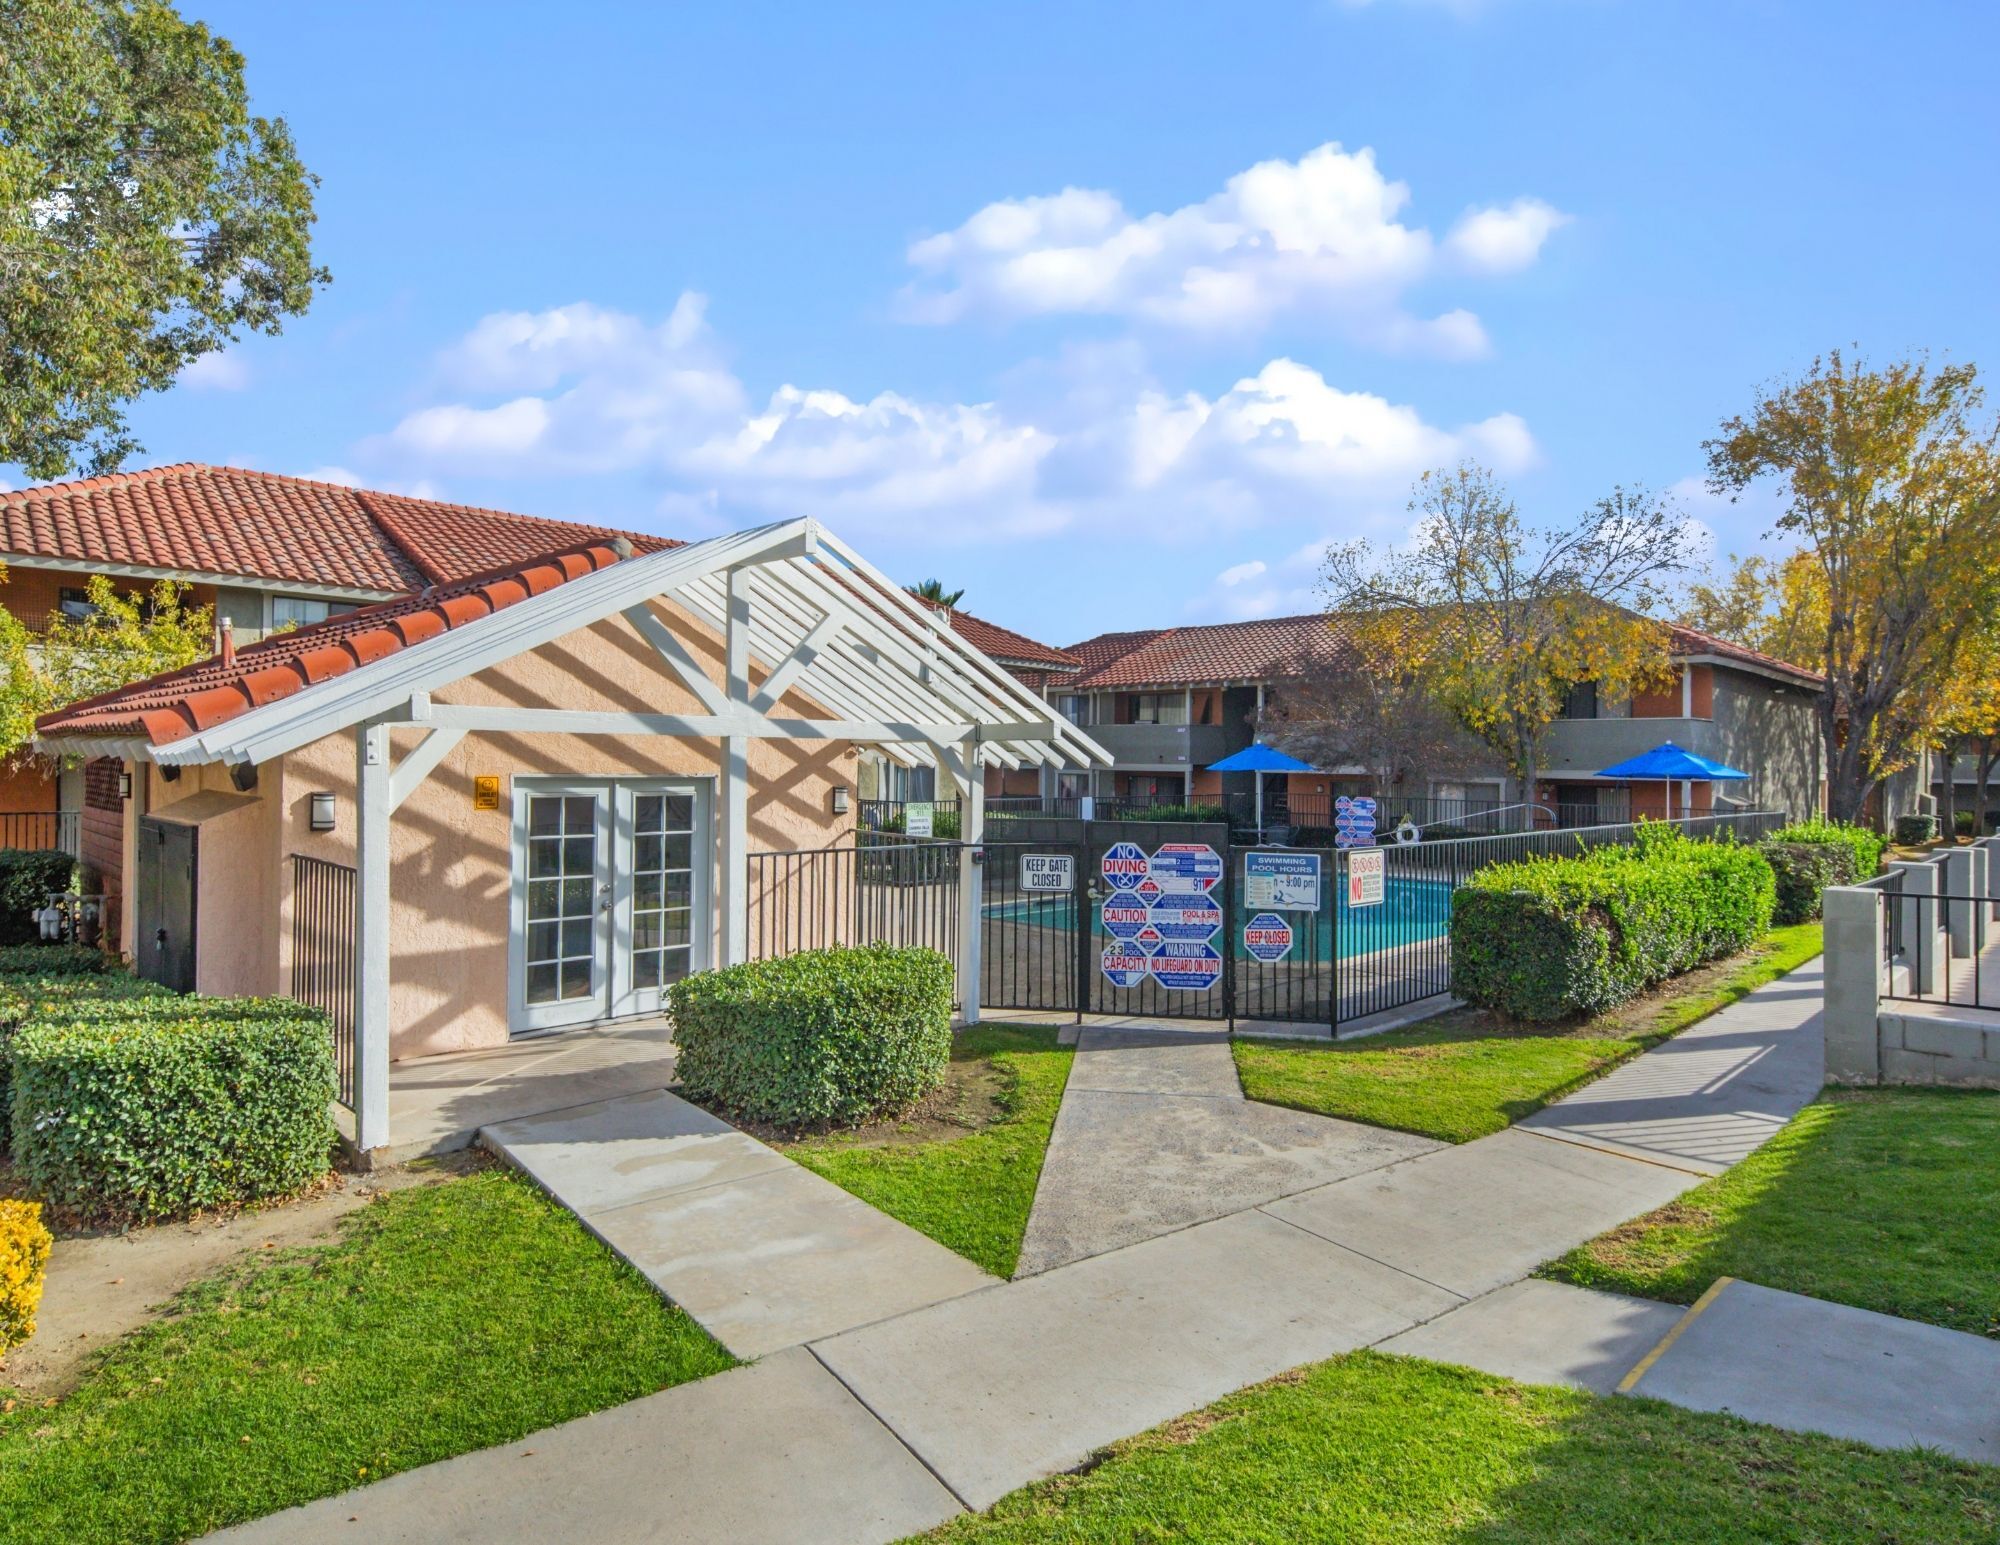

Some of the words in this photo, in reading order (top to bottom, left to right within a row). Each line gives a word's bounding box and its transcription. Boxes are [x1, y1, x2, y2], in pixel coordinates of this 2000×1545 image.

[1117, 845, 1135, 859] NO
[1026, 858, 1046, 872] KEEP
[1049, 858, 1068, 872] GATE
[1103, 860, 1147, 873] DIVING
[1252, 864, 1278, 872] POOL
[1257, 857, 1306, 865] SWIMMING
[1032, 873, 1062, 887] CLOSED
[1192, 878, 1205, 891] 911
[1285, 876, 1302, 888] 9:00
[1303, 879, 1315, 891] pm
[1352, 876, 1362, 901] NO
[1103, 908, 1147, 922] CAUTION
[1182, 910, 1200, 918] POOL
[1245, 930, 1263, 944] KEEP
[1264, 930, 1290, 944] CLOSED
[1165, 943, 1206, 958] WARNING
[1103, 956, 1147, 971] CAPACITY
[1151, 958, 1160, 971] NO
[1161, 958, 1193, 972] LIFEGUARD
[1194, 959, 1204, 973] ON
[1204, 960, 1220, 973] DUTY
